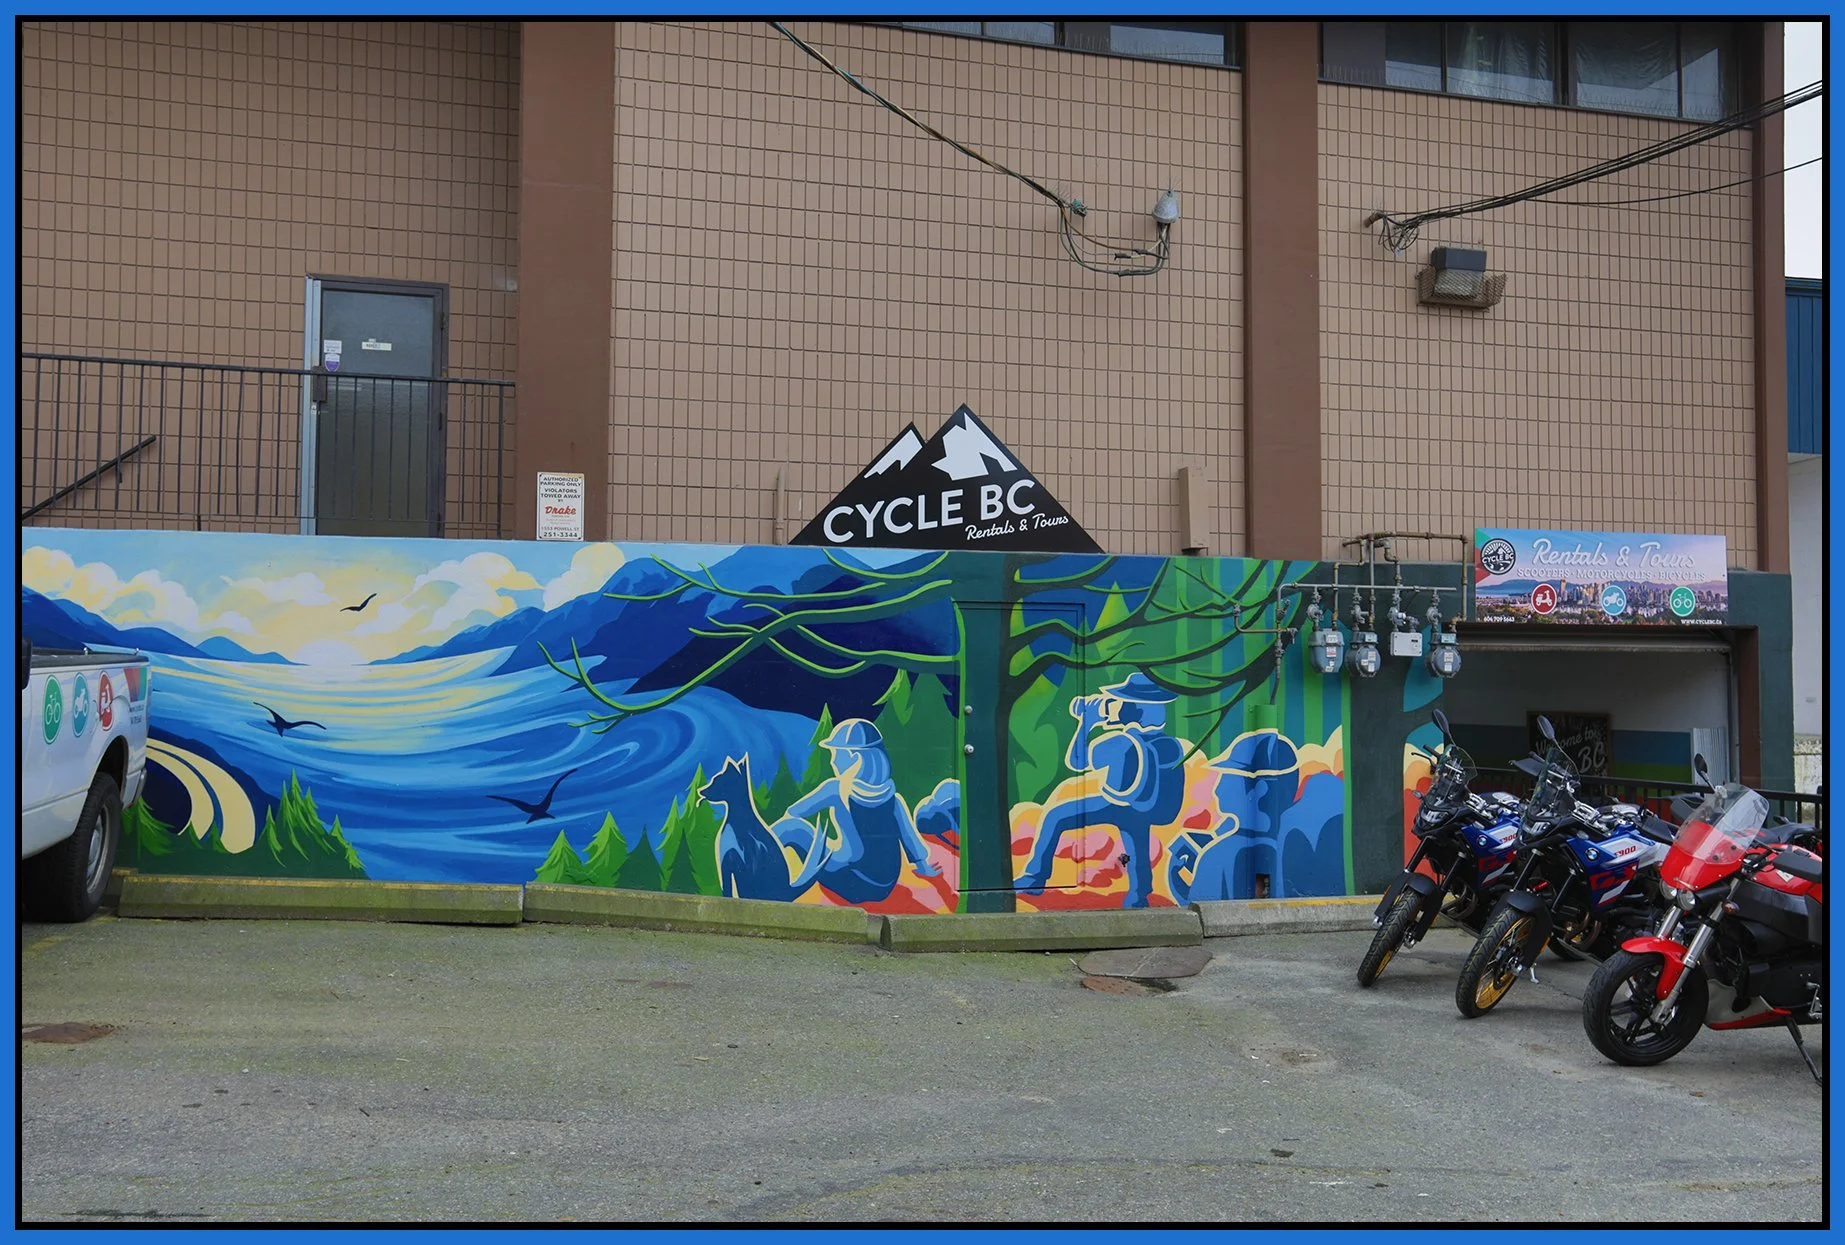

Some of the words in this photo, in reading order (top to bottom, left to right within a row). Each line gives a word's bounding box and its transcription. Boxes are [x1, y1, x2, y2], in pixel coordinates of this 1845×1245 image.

[545, 506, 576, 514] Drake
[823, 488, 964, 543] CYCLE
[980, 479, 1036, 521] BC
[965, 522, 1015, 541] Rentals
[1019, 520, 1029, 532] &
[1032, 512, 1069, 530] Tours
[1482, 553, 1504, 564] CYCLE
[1531, 538, 1609, 567] Rentals
[1615, 546, 1631, 568] &
[1639, 541, 1697, 568] Tours
[1517, 568, 1570, 578] SCOOTERS
[1577, 569, 1651, 581] MOTORCYCLES
[1658, 571, 1706, 582] BICYCLES
[1578, 742, 1606, 774] BC
